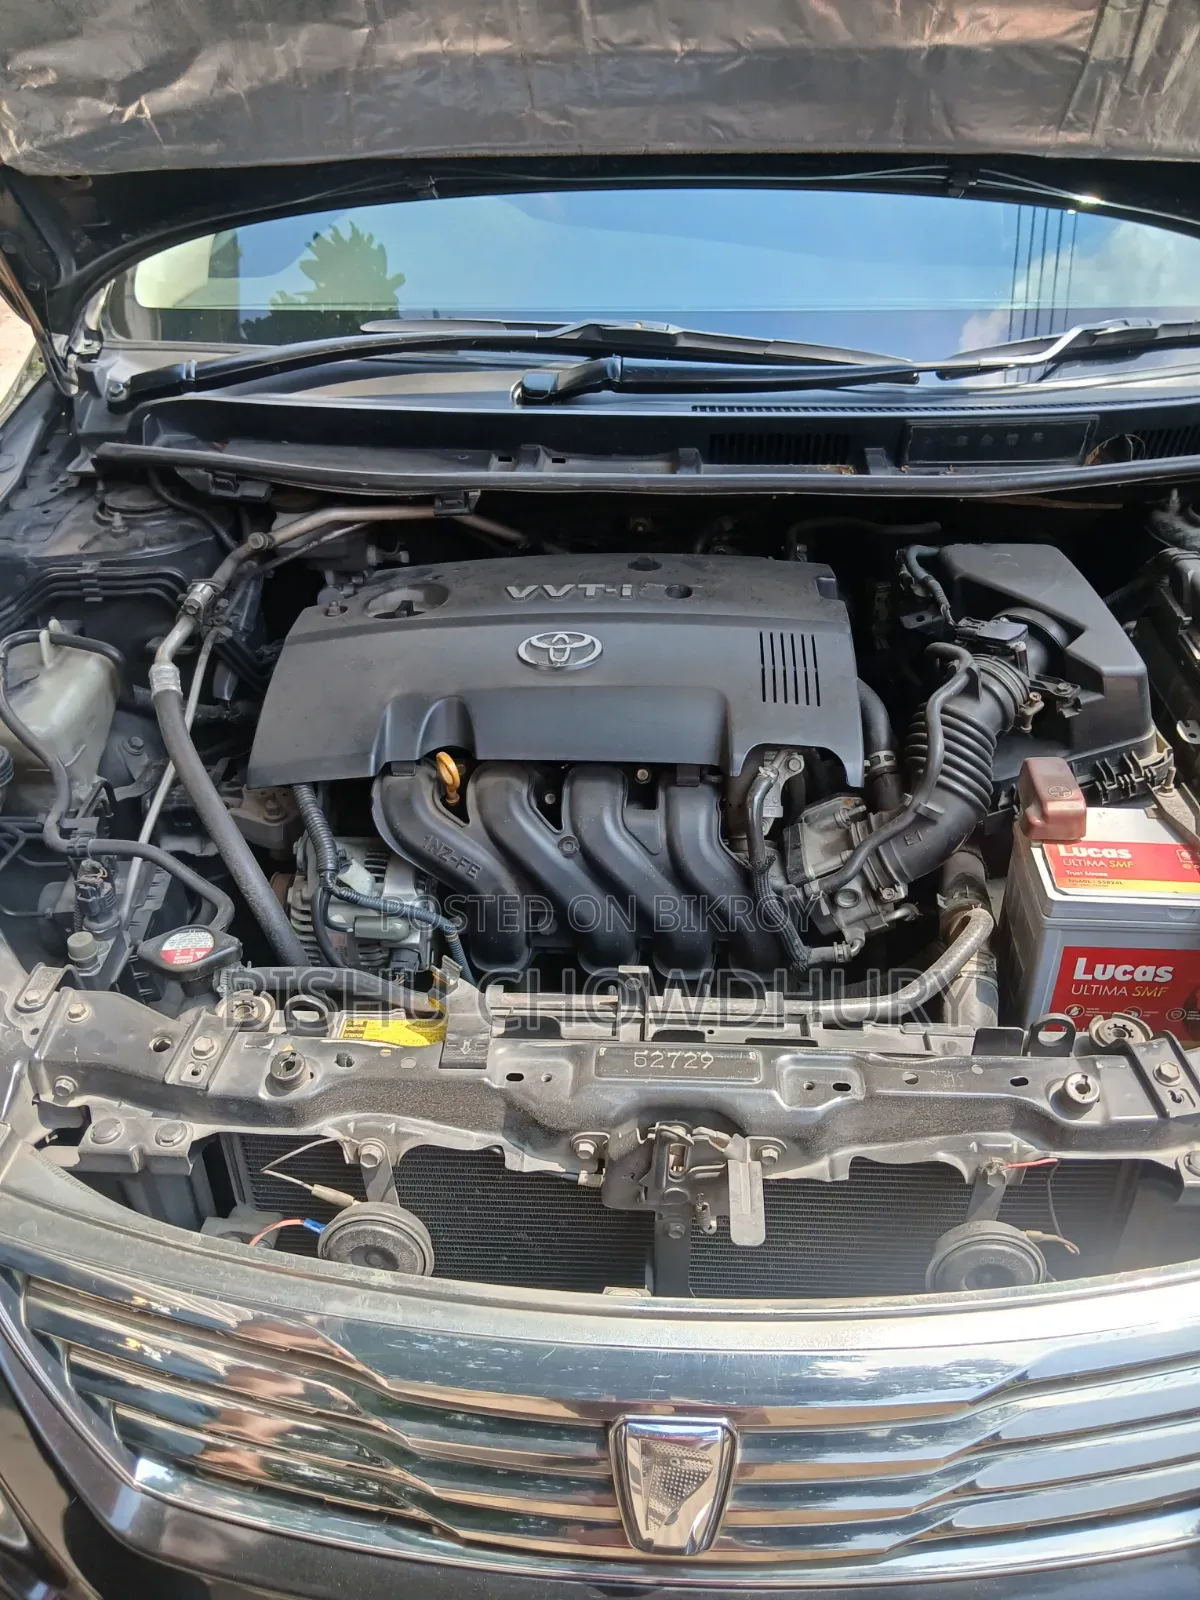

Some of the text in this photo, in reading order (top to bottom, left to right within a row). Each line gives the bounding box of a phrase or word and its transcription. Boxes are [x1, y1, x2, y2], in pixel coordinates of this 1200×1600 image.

[421, 834, 482, 879] 1NZ-FE
[1058, 843, 1132, 859] Lucas
[1062, 859, 1134, 868] ULTIMA SMF
[1073, 957, 1174, 983] Lucas
[1071, 984, 1169, 998] ULTIMA SMF
[633, 1050, 715, 1070] 52729
